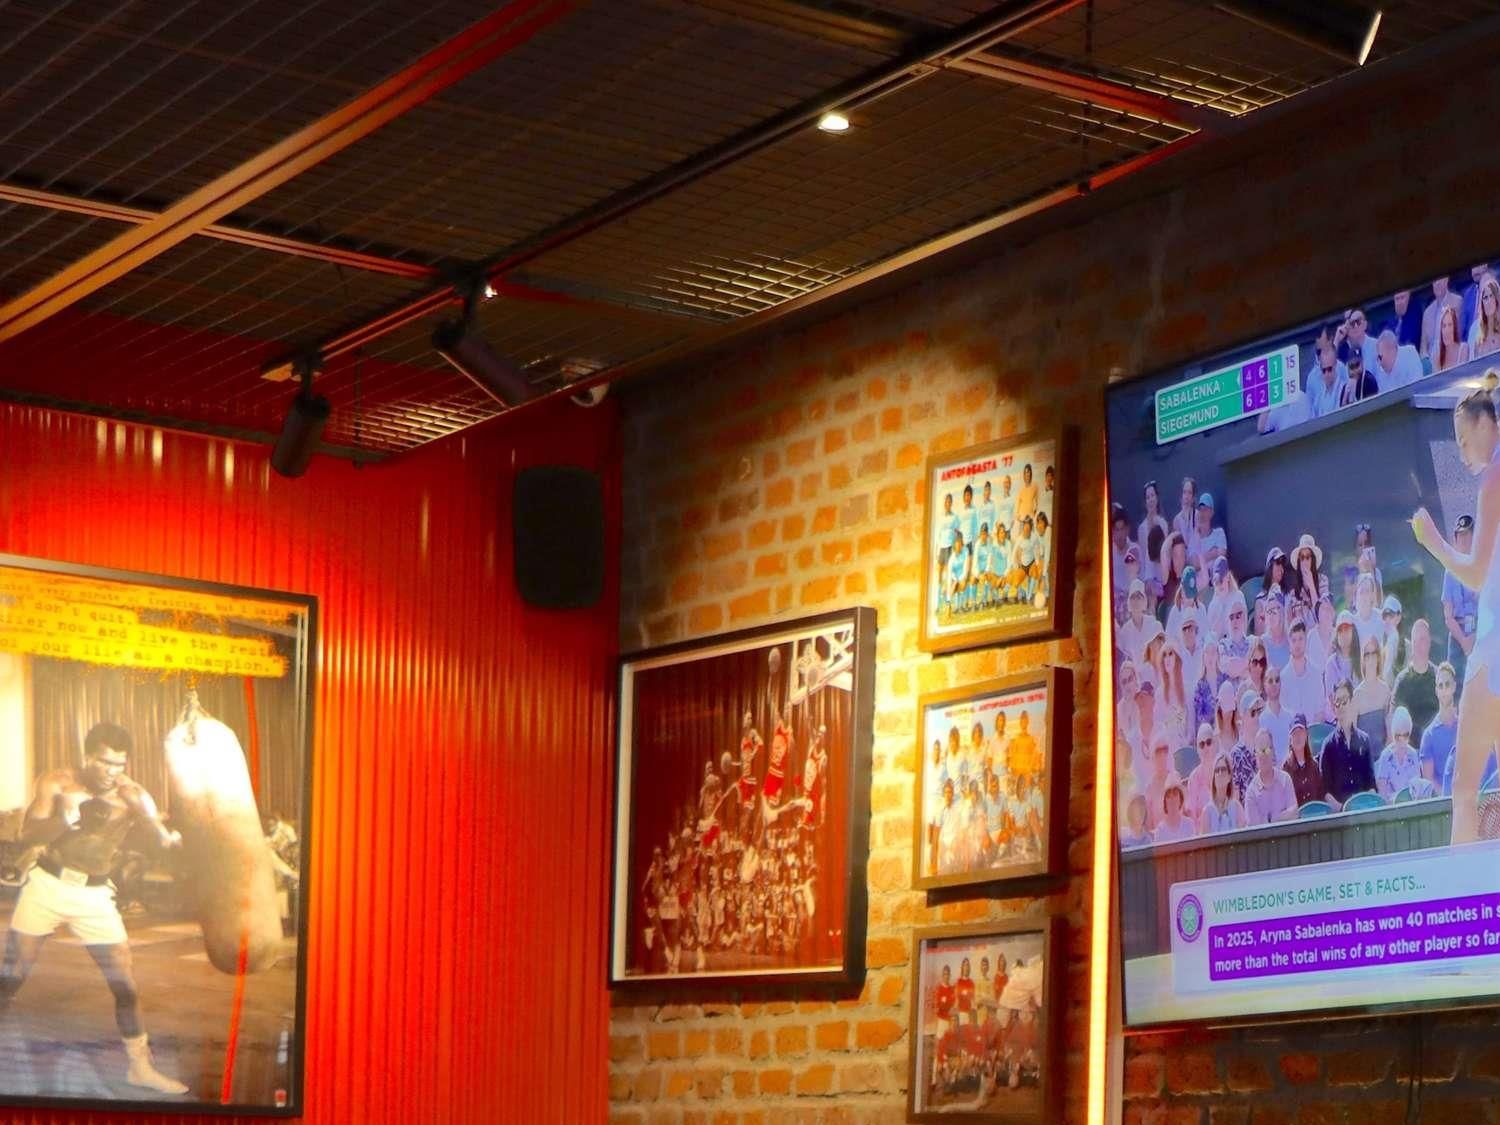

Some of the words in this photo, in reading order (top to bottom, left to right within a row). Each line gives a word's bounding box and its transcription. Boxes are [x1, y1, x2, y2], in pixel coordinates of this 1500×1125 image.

[1159, 380, 1221, 411] SABALENKA
[1245, 371, 1252, 381] 4
[1258, 365, 1265, 378] 6
[1272, 361, 1278, 374] 1
[1286, 355, 1296, 369] 15
[1160, 405, 1219, 435] SIEGEMUND
[1246, 394, 1253, 407] 6
[1260, 390, 1266, 403] 2
[1273, 386, 1280, 398] 3
[1286, 380, 1296, 393] 15
[1213, 891, 1294, 914] WIMBLEDON'S
[1298, 886, 1336, 903] GAME,
[1339, 881, 1361, 899] SET
[1364, 880, 1373, 896] &
[1377, 875, 1426, 895] FACTS...
[1214, 935, 1224, 948] In
[1227, 930, 1257, 947] 2025,
[1260, 928, 1292, 945] Aryna
[1295, 919, 1352, 940] Sabalenka
[1355, 918, 1375, 933] has
[1379, 916, 1403, 931] won
[1406, 911, 1423, 927] 40
[1427, 906, 1478, 926] matches
[1481, 904, 1493, 920] in
[1215, 958, 1242, 973] more
[1245, 954, 1269, 970] than
[1271, 951, 1289, 966] the
[1292, 948, 1318, 965] total
[1321, 946, 1347, 961] wins
[1350, 943, 1362, 959] of
[1365, 944, 1386, 960] any
[1389, 938, 1421, 956] other
[1424, 934, 1462, 955] player
[1465, 933, 1481, 948] so
[1483, 929, 1500, 946] far
